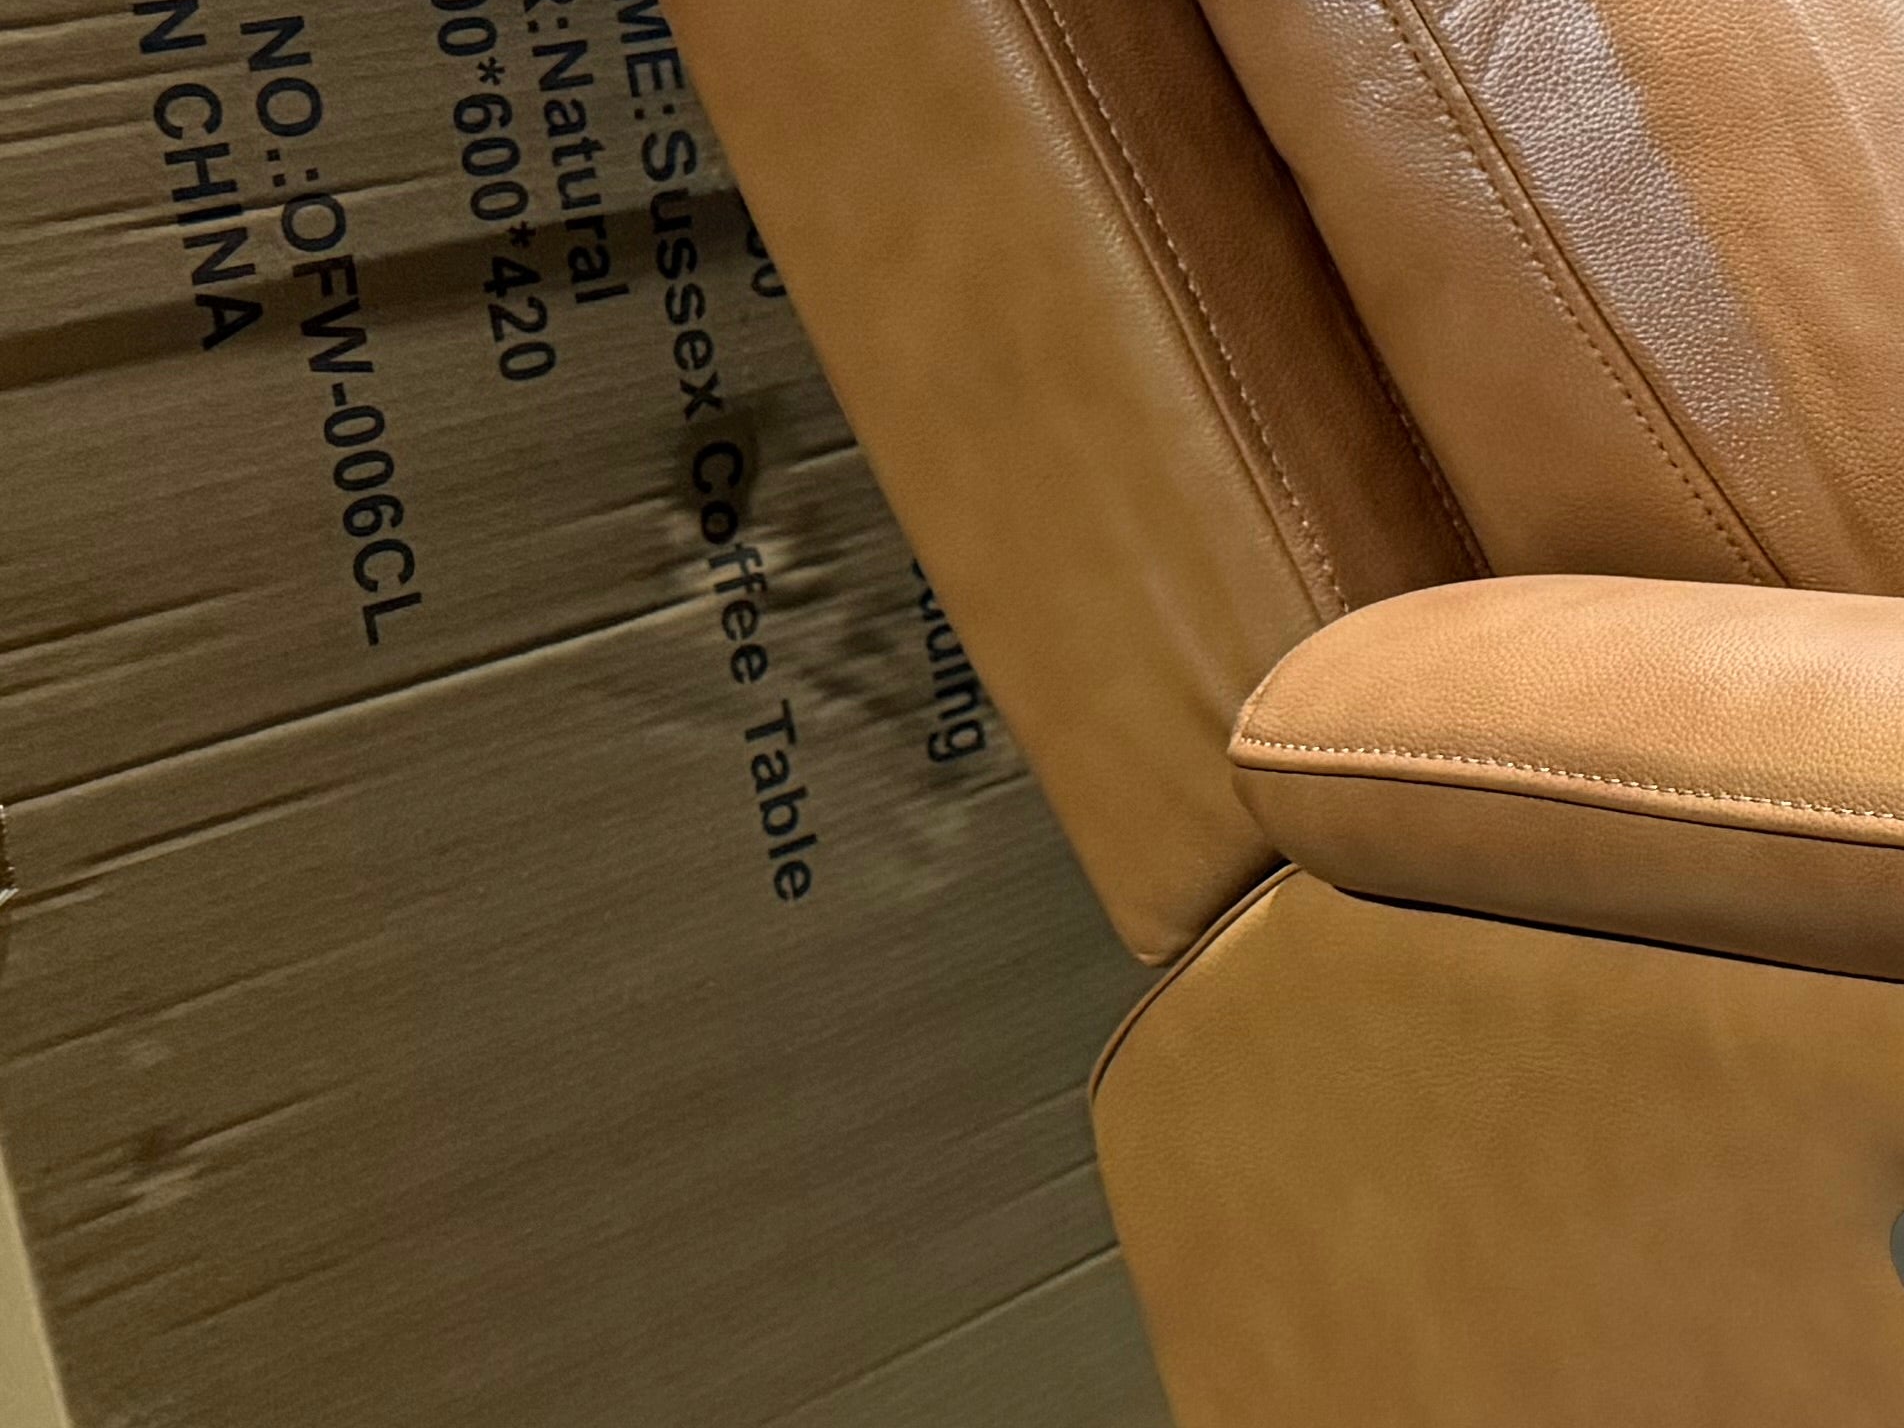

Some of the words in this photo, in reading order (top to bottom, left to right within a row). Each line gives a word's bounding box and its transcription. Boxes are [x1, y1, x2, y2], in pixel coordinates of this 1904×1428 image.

[152, 82, 264, 351] CHINA
[693, 439, 768, 685] Coffee
[745, 698, 818, 903] Table
